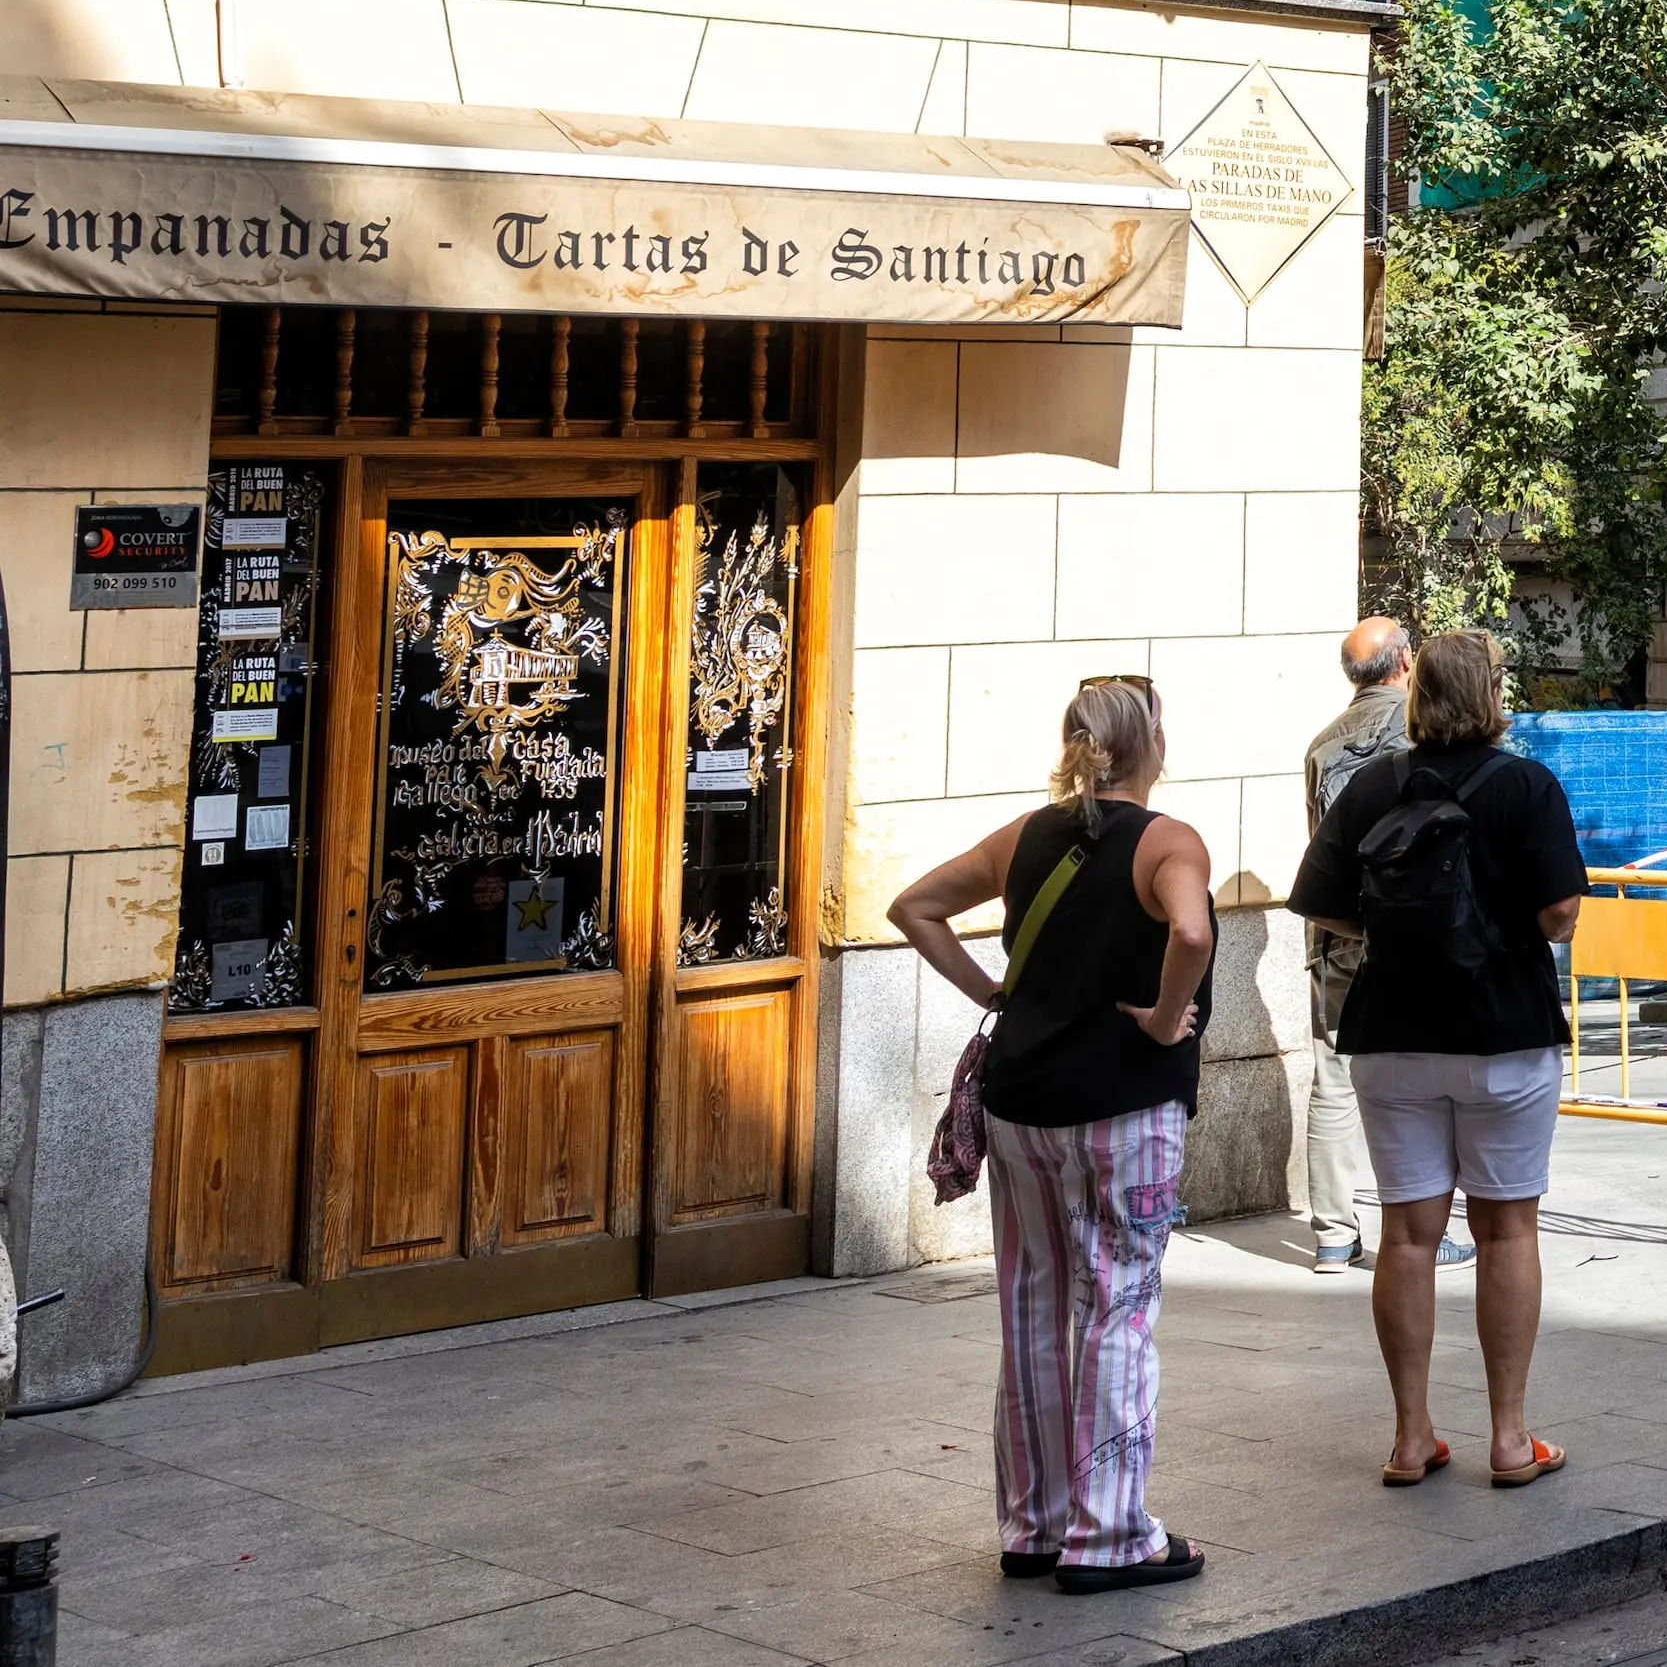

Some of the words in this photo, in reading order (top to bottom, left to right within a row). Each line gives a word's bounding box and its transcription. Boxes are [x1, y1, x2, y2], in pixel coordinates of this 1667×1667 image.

[1242, 129, 1253, 138] EN
[1256, 130, 1277, 140] ESTA
[1208, 137, 1236, 148] PLAZA
[1239, 140, 1251, 150] DE
[1253, 142, 1308, 155] HERRADORES
[1182, 148, 1240, 160] ESTUVIERON
[1242, 152, 1254, 161] EN
[1256, 153, 1264, 163] EL
[1268, 154, 1293, 165] SIGLO
[1313, 159, 1329, 169] LAS
[1212, 161, 1281, 182] PARADAS
[1285, 168, 1304, 183] DE
[1211, 181, 1262, 199] SILLAS
[1267, 185, 1286, 200] DE
[1290, 187, 1332, 205] MANO
[1201, 198, 1218, 207] LOS
[1221, 199, 1264, 212] PRIMEROS
[1267, 201, 1291, 213] TAXIS
[1293, 205, 1310, 215] QUE
[1200, 210, 1256, 223] CIRCULARON
[1258, 213, 1275, 224] POR
[1277, 215, 1309, 227] MADRID
[0, 188, 391, 264] Empanadas
[493, 211, 711, 275] Tartas
[742, 228, 800, 277] de
[830, 226, 1088, 295] Santiago
[241, 468, 252, 478] LA
[254, 467, 283, 478] RUTA
[241, 480, 255, 490] DEL
[257, 479, 283, 490] BUEN
[240, 491, 283, 511] PAN
[120, 533, 188, 545] COVERT
[118, 547, 186, 556] SECURITY
[237, 557, 248, 568] LA
[250, 556, 280, 568] RUTA
[236, 569, 250, 581] DEL
[252, 568, 280, 580] BUEN
[94, 579, 118, 590] 902
[122, 578, 147, 589] 099
[152, 577, 177, 588] 510
[236, 581, 279, 602] PAN
[233, 658, 243, 669] LA
[246, 657, 276, 669] RUTA
[232, 671, 246, 682] DEL
[248, 670, 276, 681] BUEN
[231, 682, 275, 704] PAN
[228, 964, 251, 977] L10
